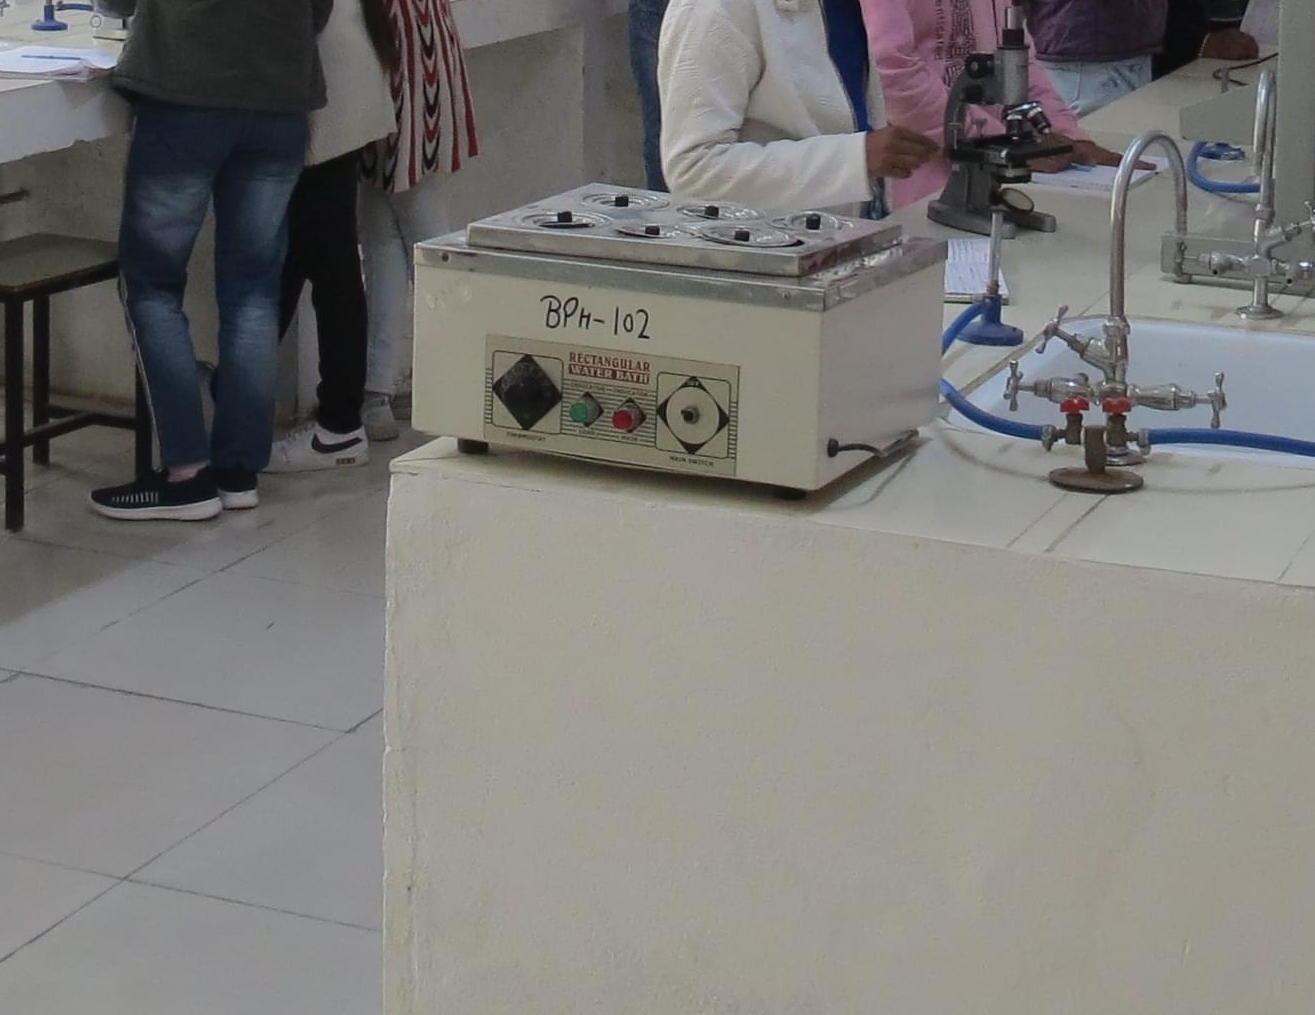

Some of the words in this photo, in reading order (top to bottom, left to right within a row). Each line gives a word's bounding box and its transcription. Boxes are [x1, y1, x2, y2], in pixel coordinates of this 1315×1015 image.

[569, 351, 650, 372] RECTANGULAR
[571, 365, 613, 379] WATER
[615, 369, 650, 384] BATH
